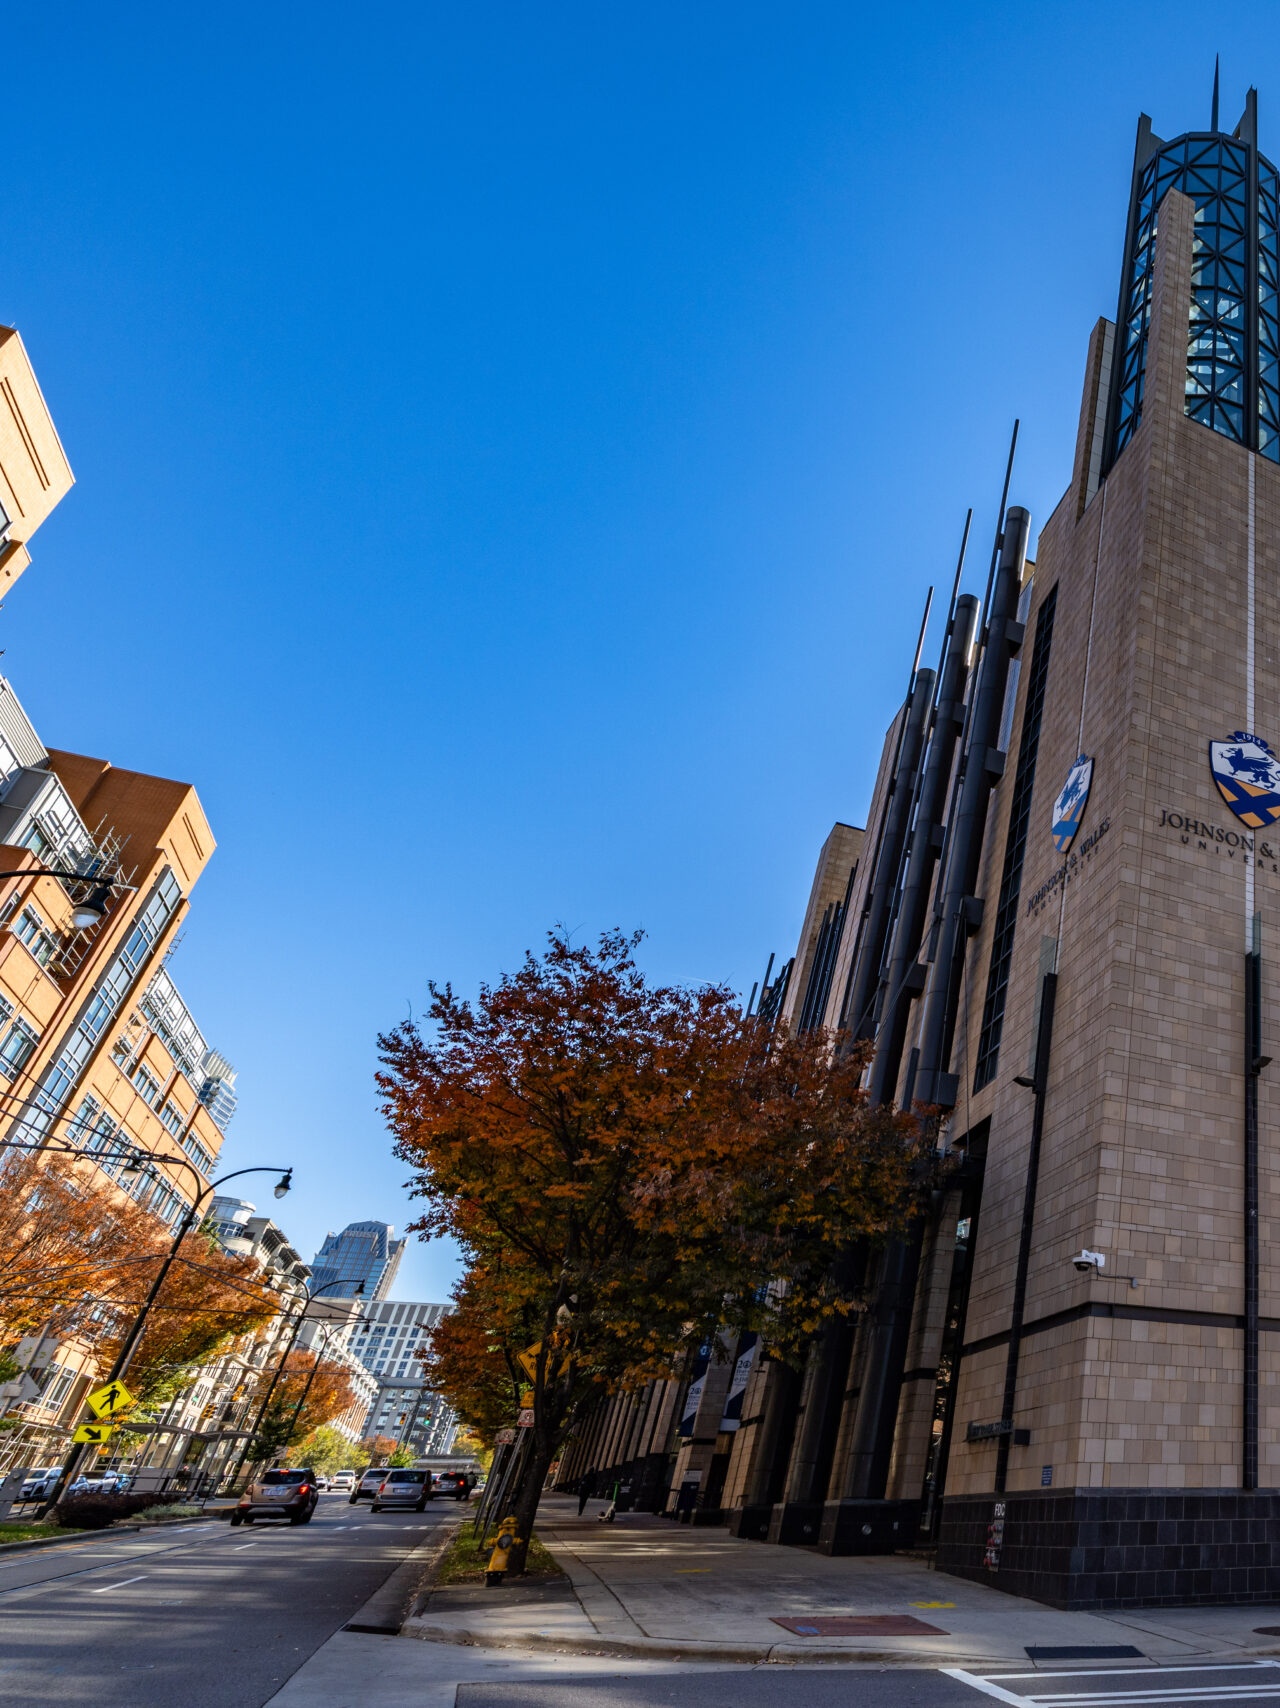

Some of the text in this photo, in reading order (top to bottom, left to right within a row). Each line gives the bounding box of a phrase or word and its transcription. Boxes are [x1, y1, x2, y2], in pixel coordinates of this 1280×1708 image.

[1242, 733, 1261, 745] 1914
[1159, 810, 1254, 851] JOHNSON
[1259, 842, 1274, 858] &
[1026, 865, 1068, 917] JOHNSON
[1079, 816, 1111, 857] WALES
[994, 1503, 1006, 1517] FDC
